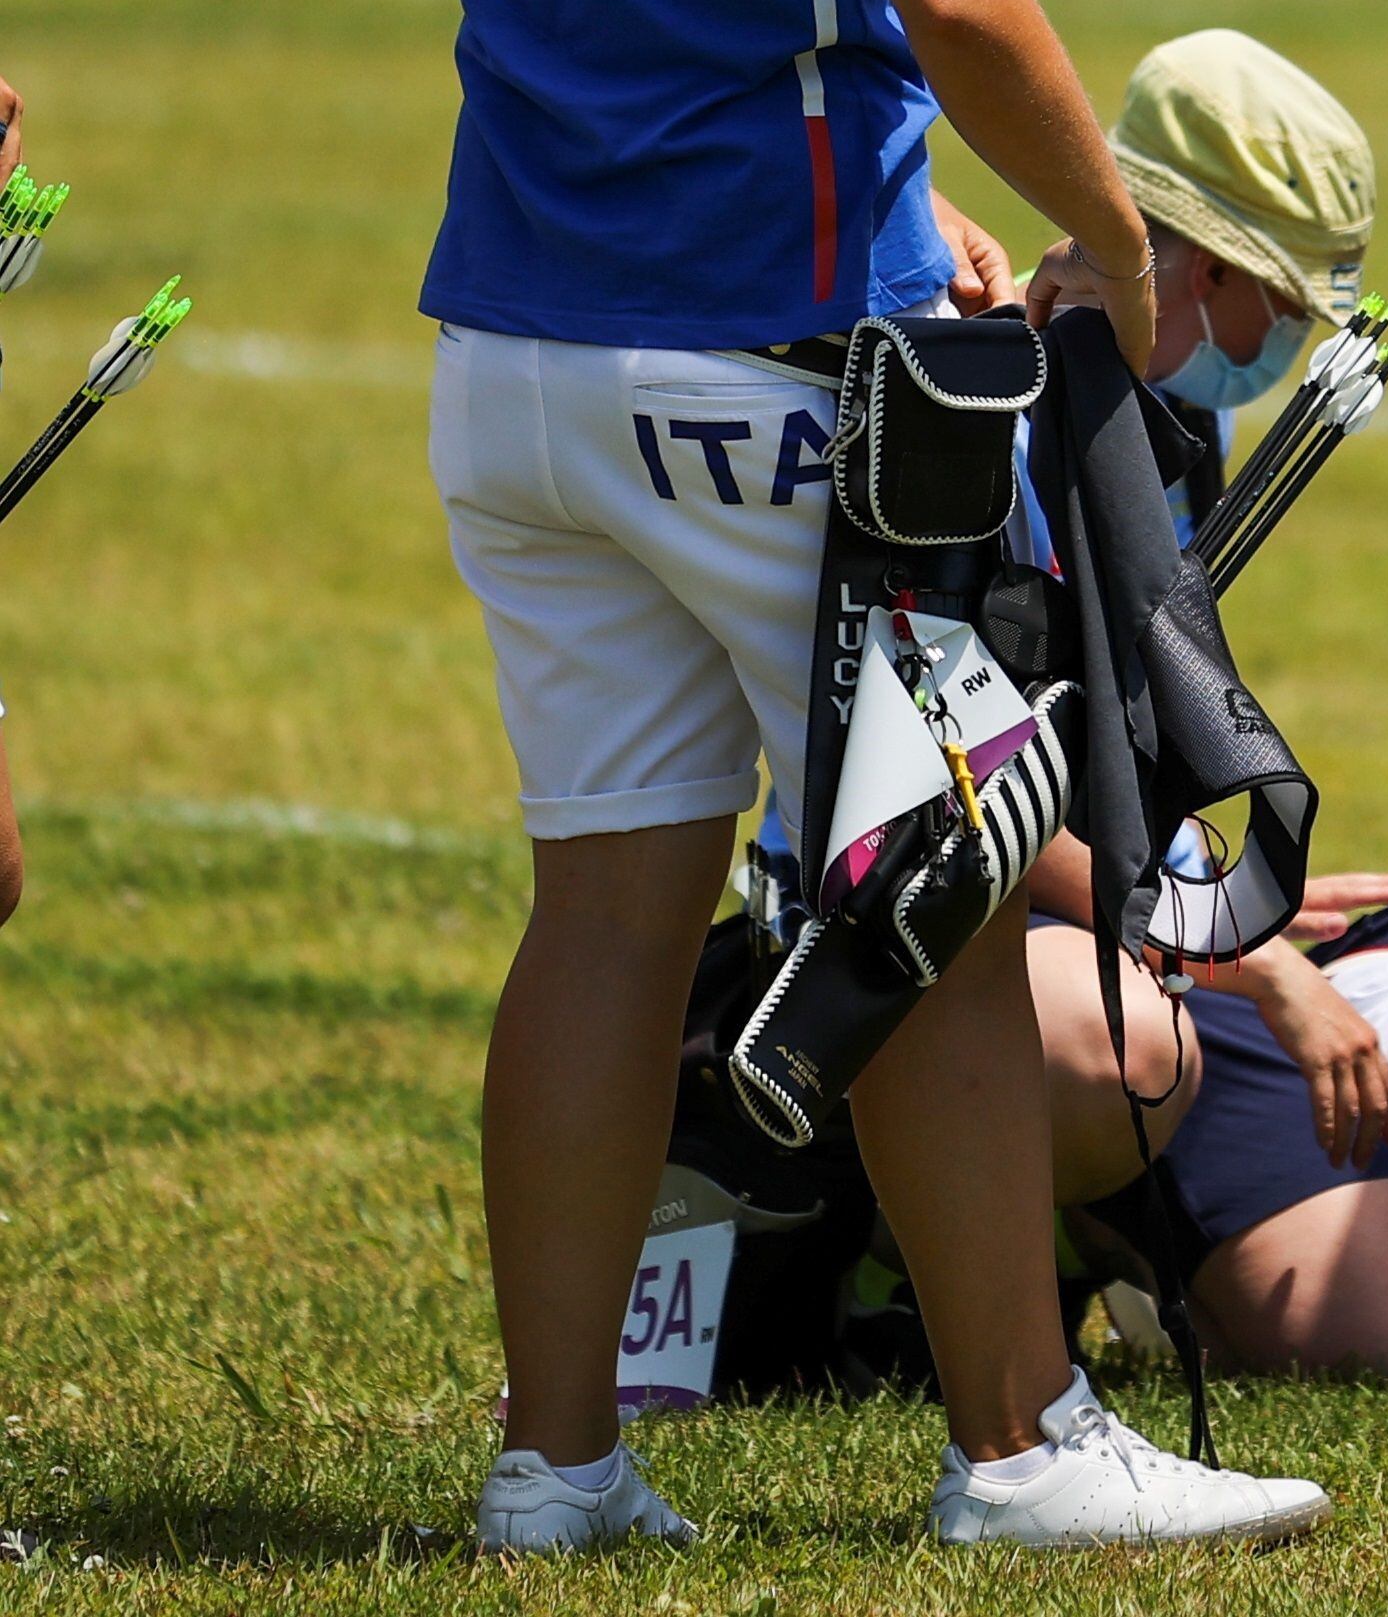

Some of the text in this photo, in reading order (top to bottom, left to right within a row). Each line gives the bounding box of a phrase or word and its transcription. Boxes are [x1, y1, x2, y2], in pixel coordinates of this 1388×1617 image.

[632, 409, 836, 505] ITA
[830, 583, 867, 725] LUCY
[961, 667, 992, 696] RW
[775, 1045, 824, 1098] ANGEL
